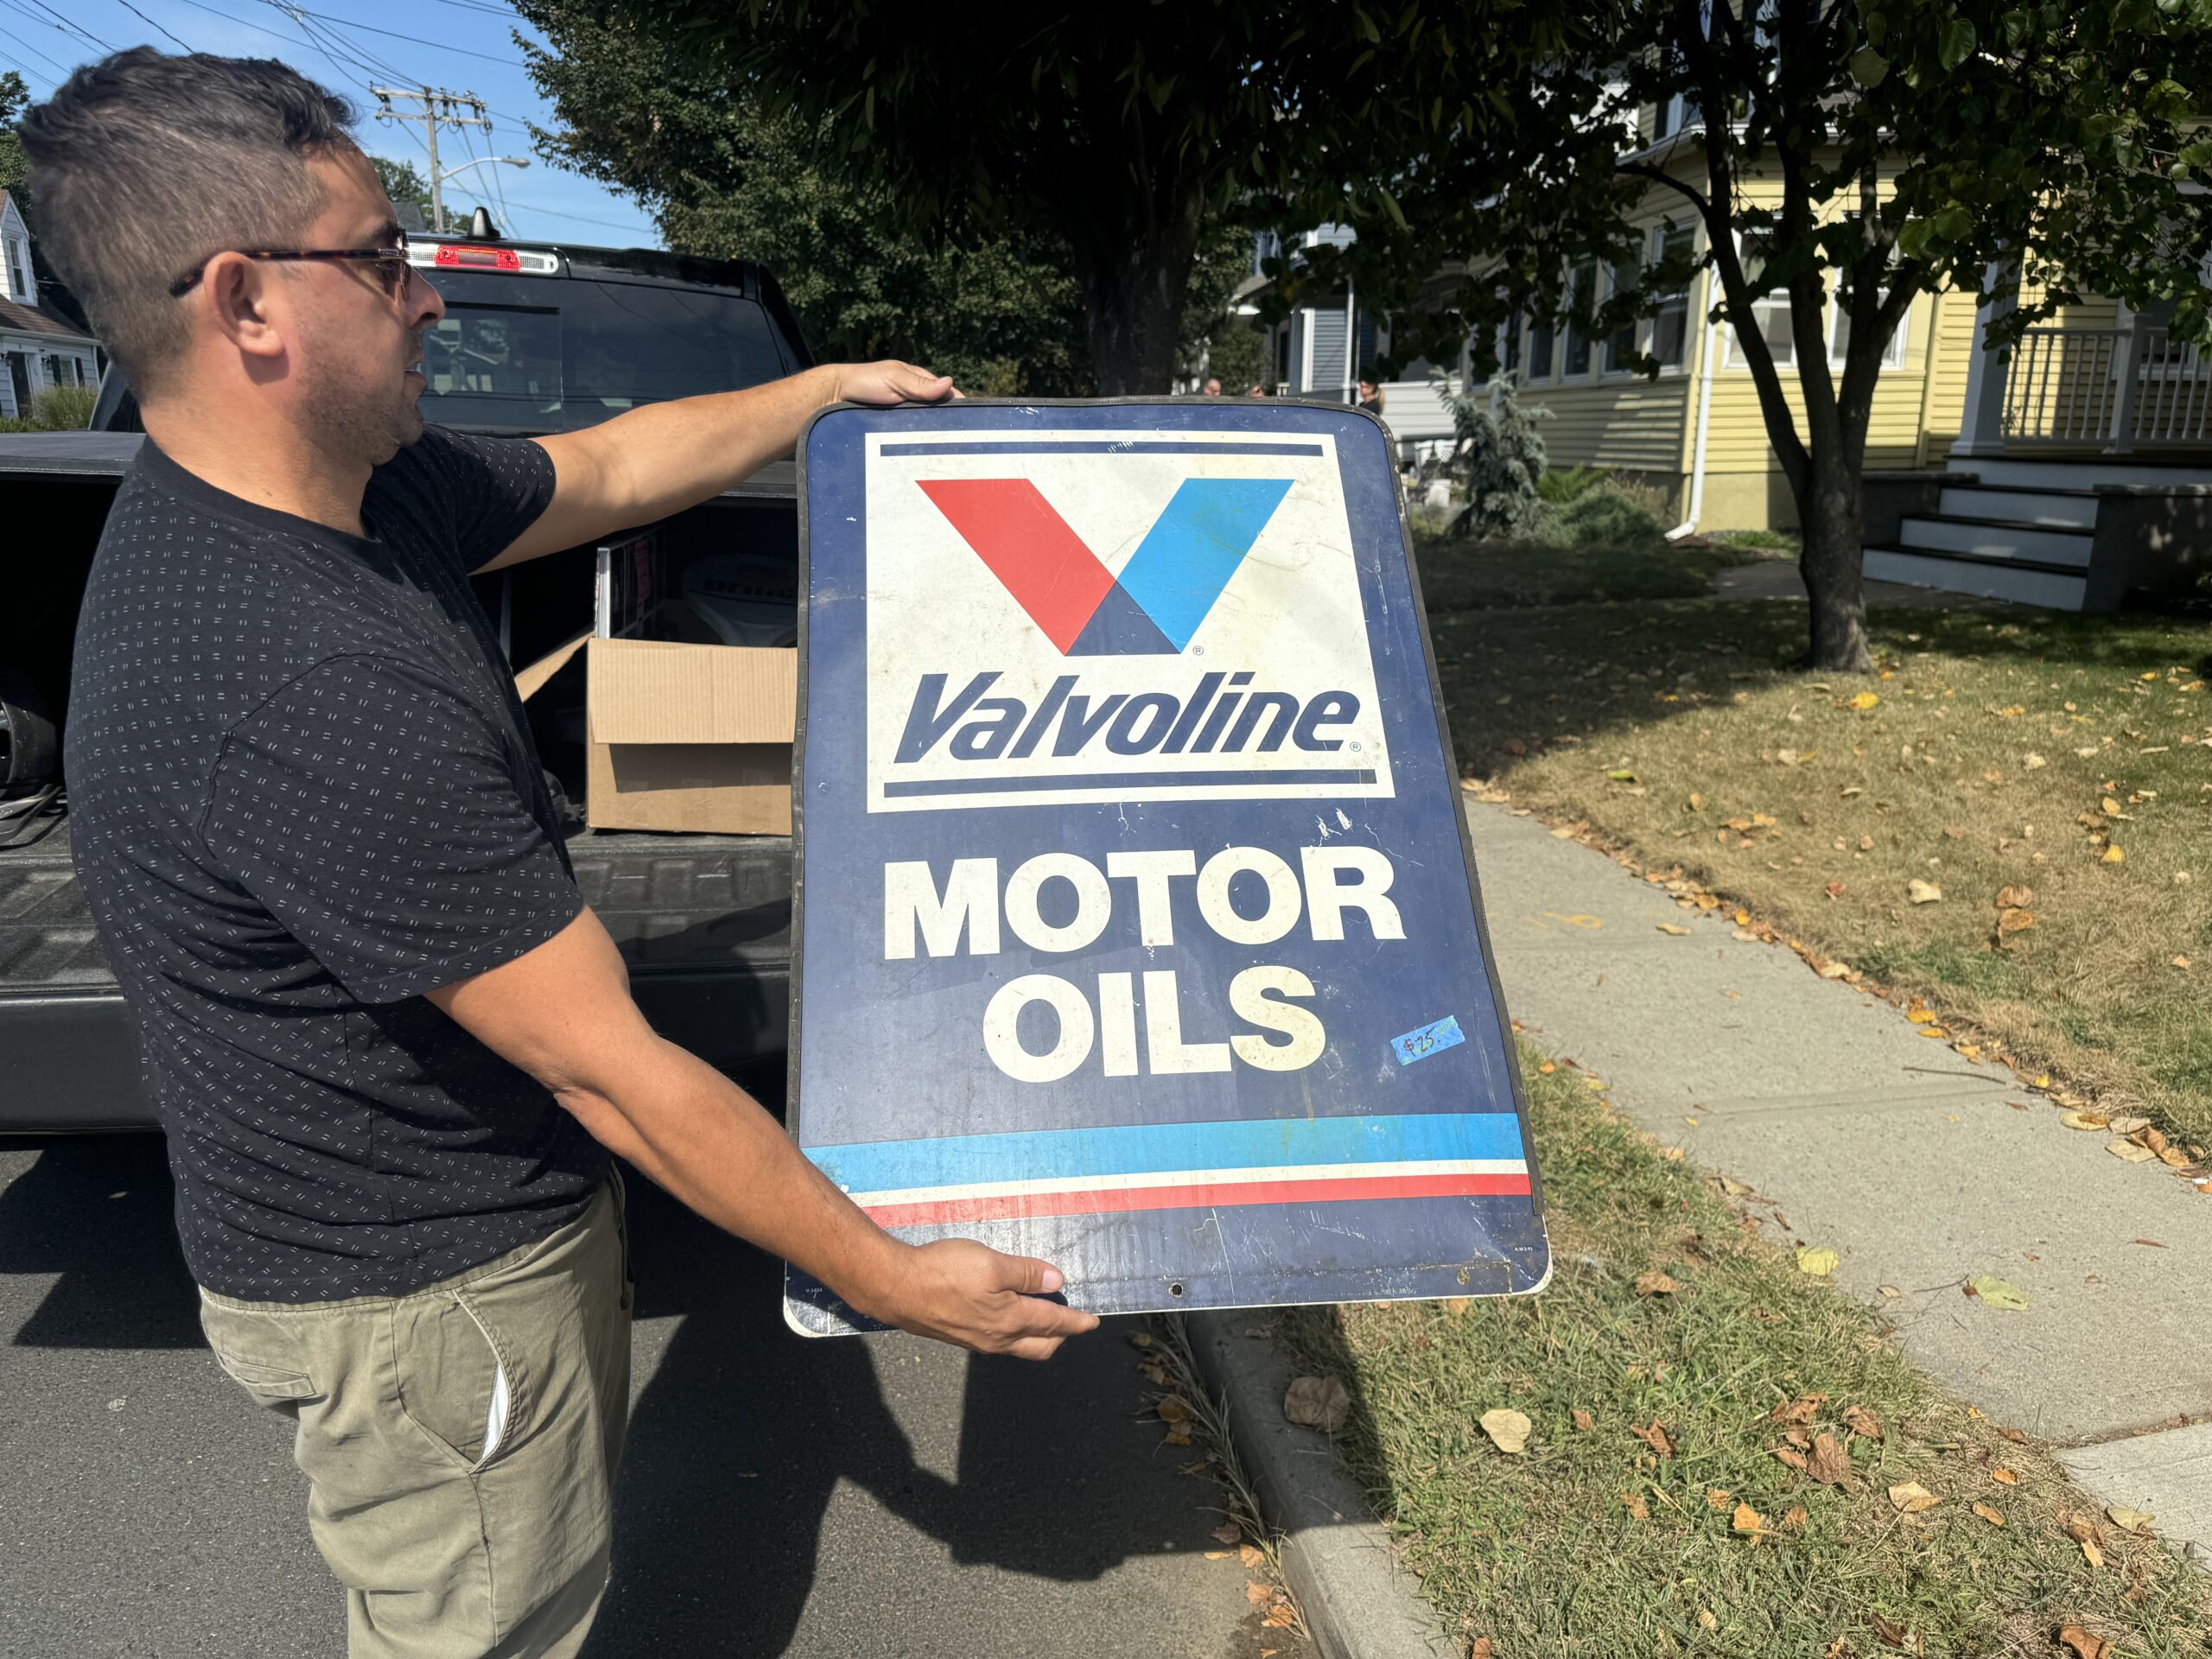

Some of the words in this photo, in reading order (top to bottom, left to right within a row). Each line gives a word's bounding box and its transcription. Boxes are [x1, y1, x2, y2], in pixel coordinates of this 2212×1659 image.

[893, 671, 1361, 764] Valvoline
[884, 845, 1407, 960] MOTOR
[982, 965, 1326, 1083] OILS
